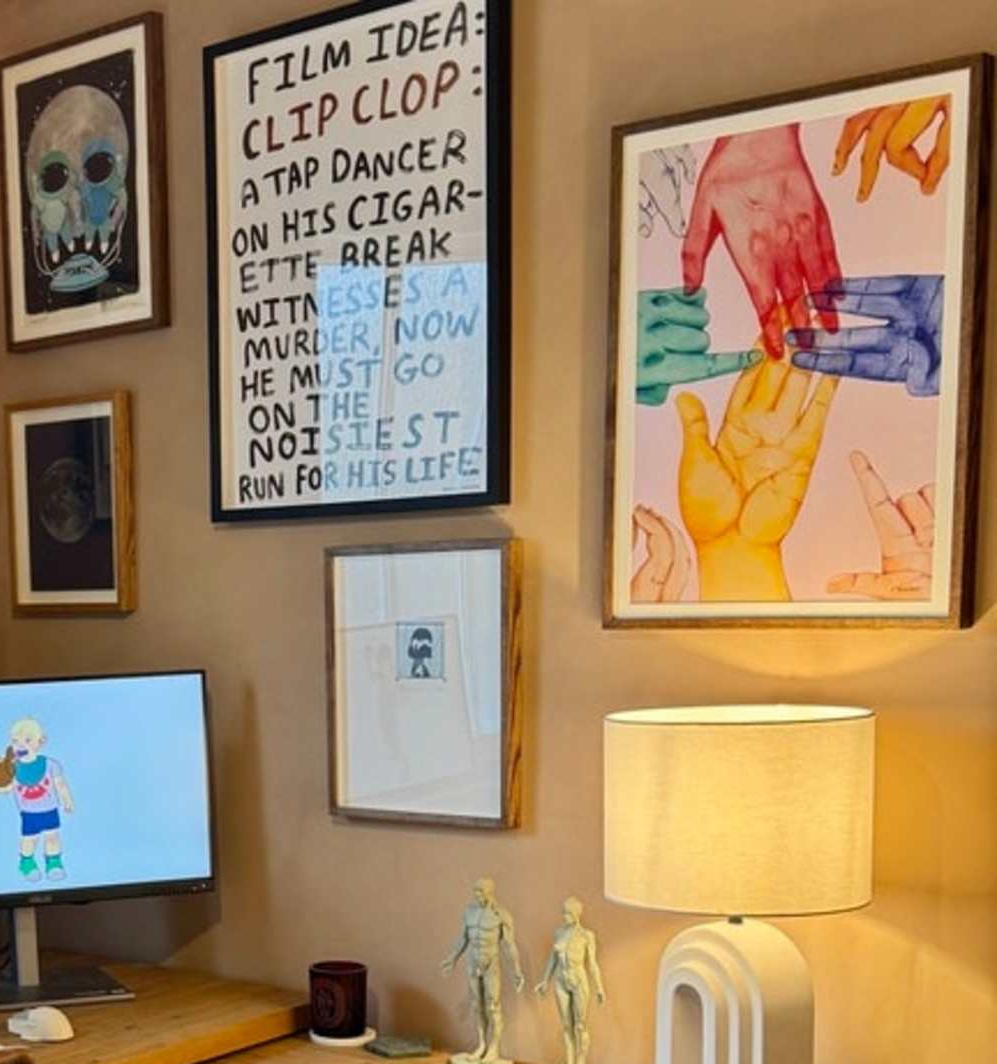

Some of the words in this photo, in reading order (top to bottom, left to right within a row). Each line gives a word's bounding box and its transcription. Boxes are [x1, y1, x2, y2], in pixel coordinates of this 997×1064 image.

[248, 40, 351, 104] FILM
[366, 1, 485, 63] IDEA:
[242, 92, 339, 160] CLIP
[240, 178, 260, 209] A
[262, 156, 319, 197] TAP
[331, 129, 467, 184] DANCER
[231, 222, 269, 258] ON
[282, 201, 336, 244] HIS
[347, 179, 483, 231] CIGAR-
[239, 250, 322, 294] ETTE
[340, 228, 452, 275] BREAK
[236, 271, 421, 332] WITNESSES
[441, 267, 469, 297] A
[393, 306, 480, 346] NOW
[240, 369, 274, 402] HE
[289, 357, 382, 394] MUST
[393, 353, 444, 386] GO
[248, 401, 296, 434] ON
[306, 391, 370, 423] THE
[249, 410, 459, 469] NOISIEST
[238, 471, 285, 504] RUN
[296, 460, 340, 495] FOR
[347, 460, 397, 489] HIS
[405, 446, 482, 484] LIFE
